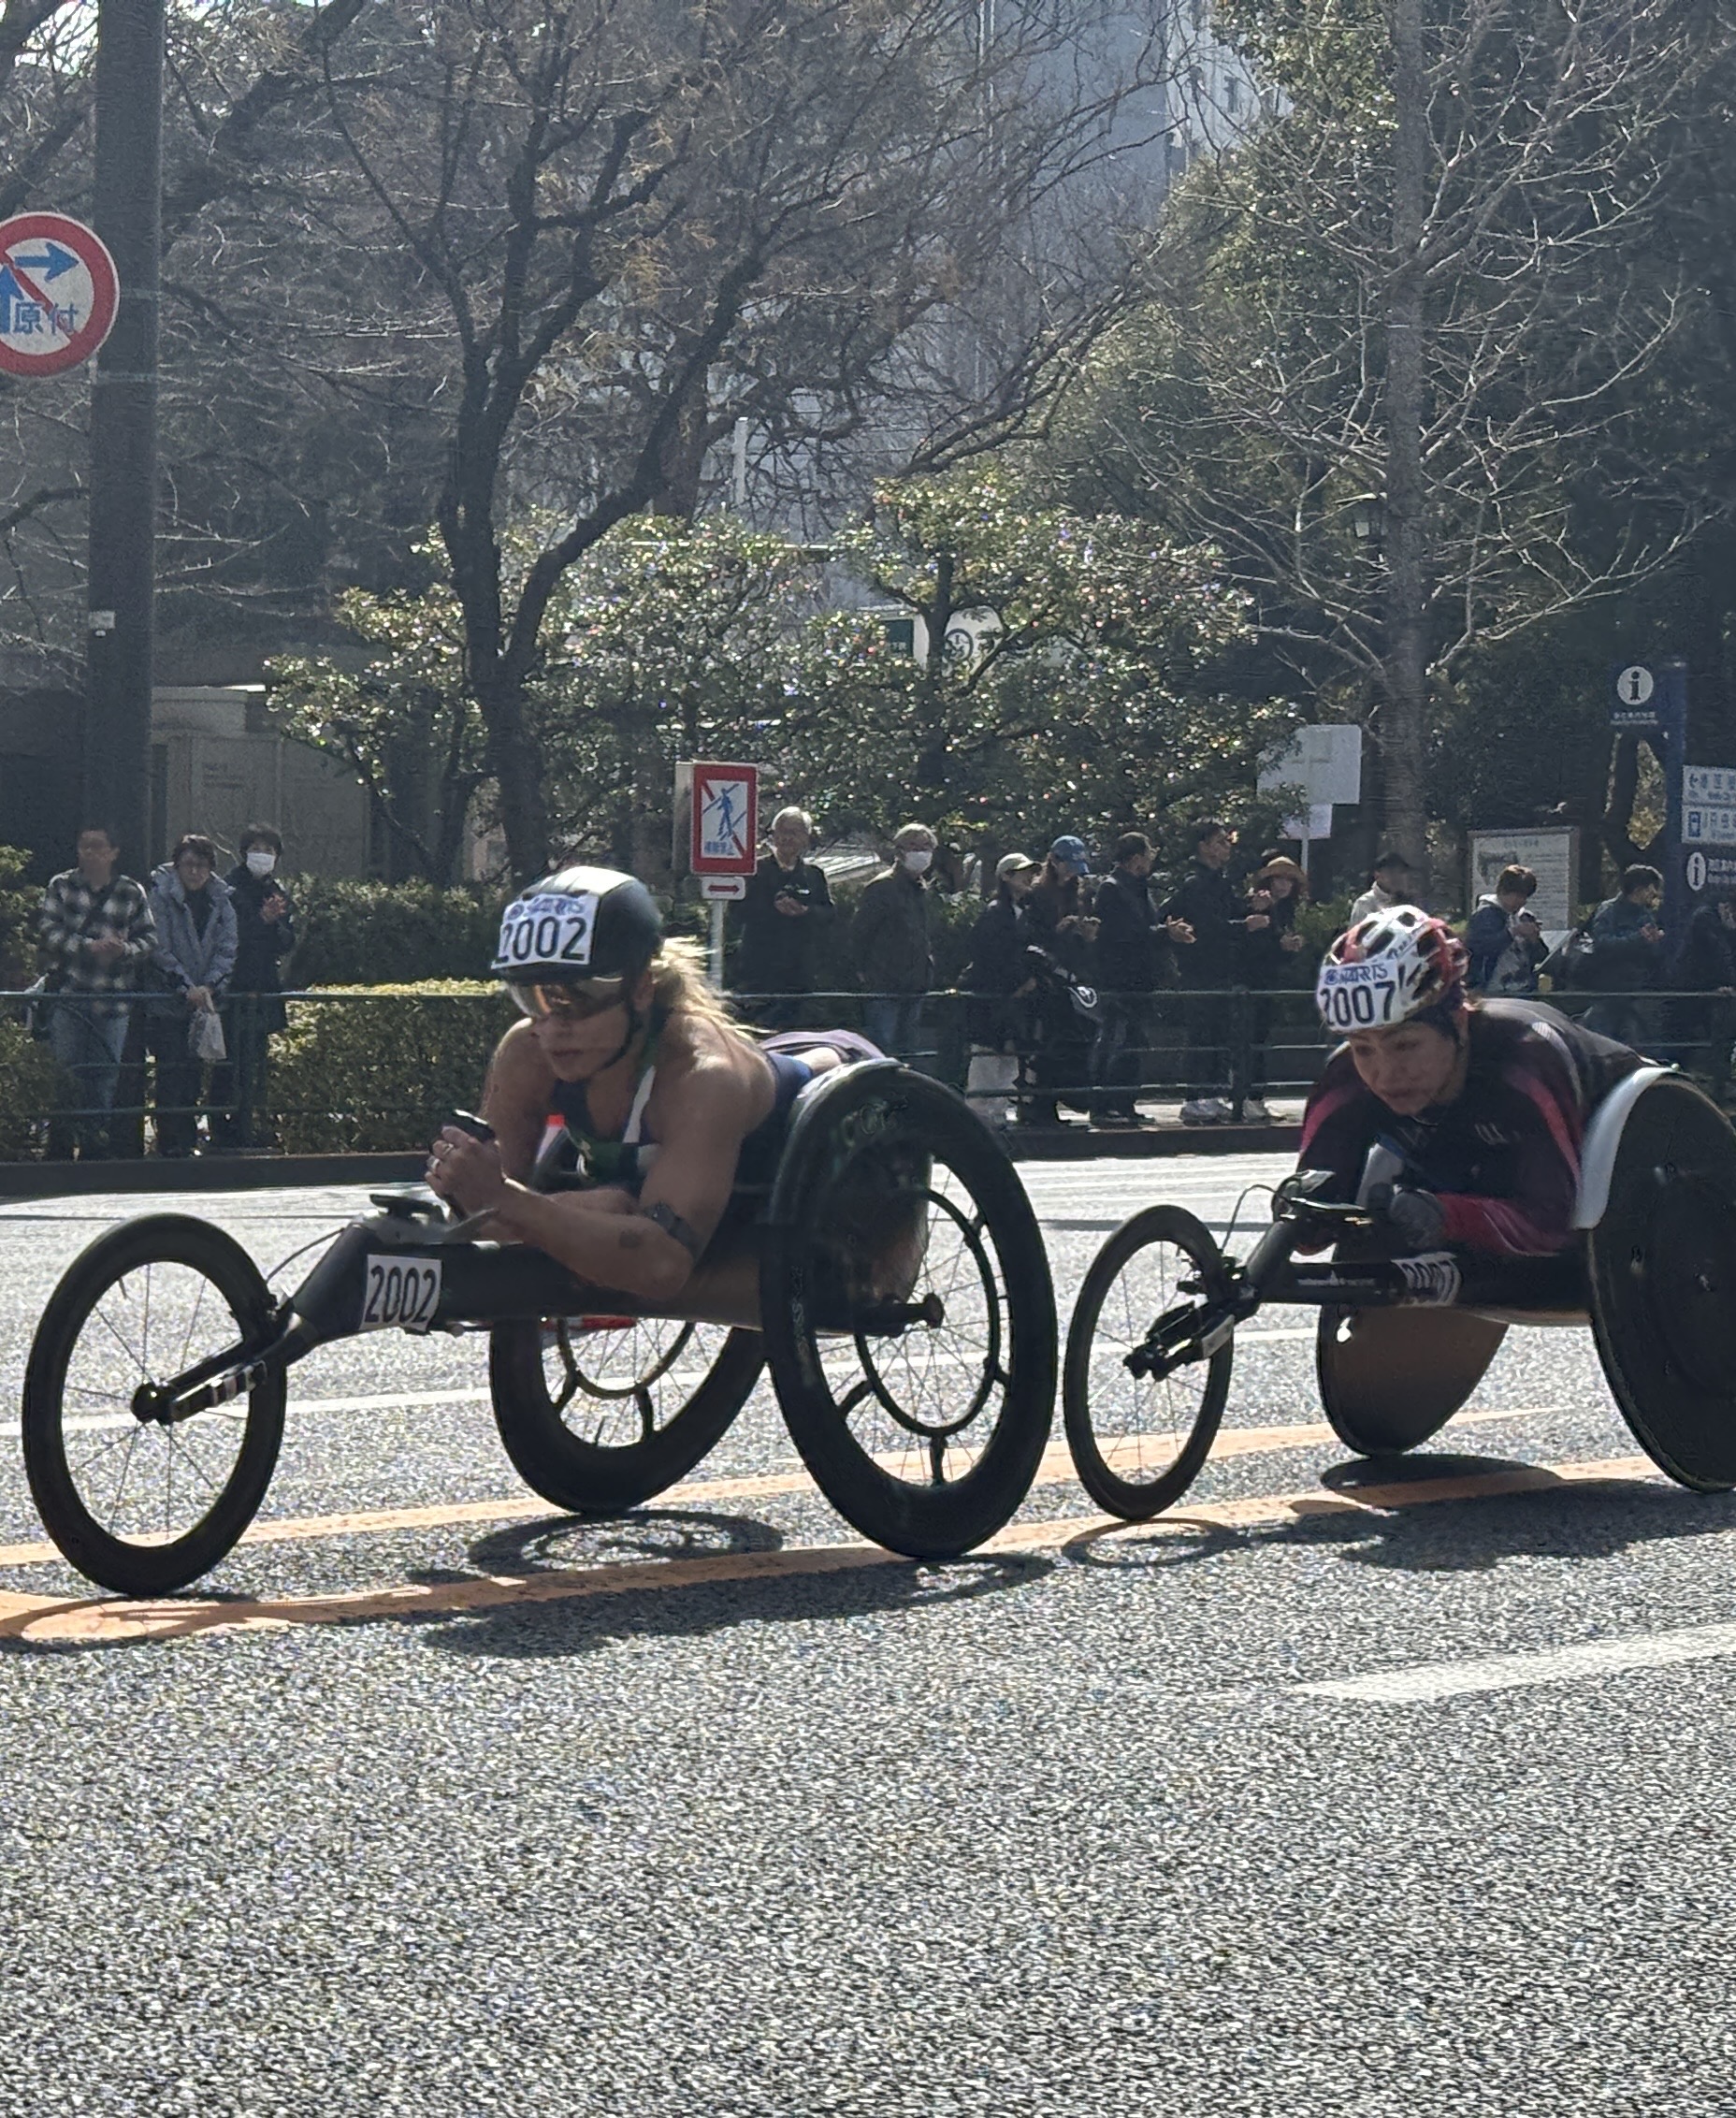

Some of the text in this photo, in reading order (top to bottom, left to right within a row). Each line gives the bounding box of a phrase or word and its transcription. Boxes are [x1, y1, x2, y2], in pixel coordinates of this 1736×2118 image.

[15, 302, 79, 335] 原付
[494, 916, 587, 965] 2002
[1320, 980, 1396, 1027] 2007
[364, 1265, 437, 1323] 2002
